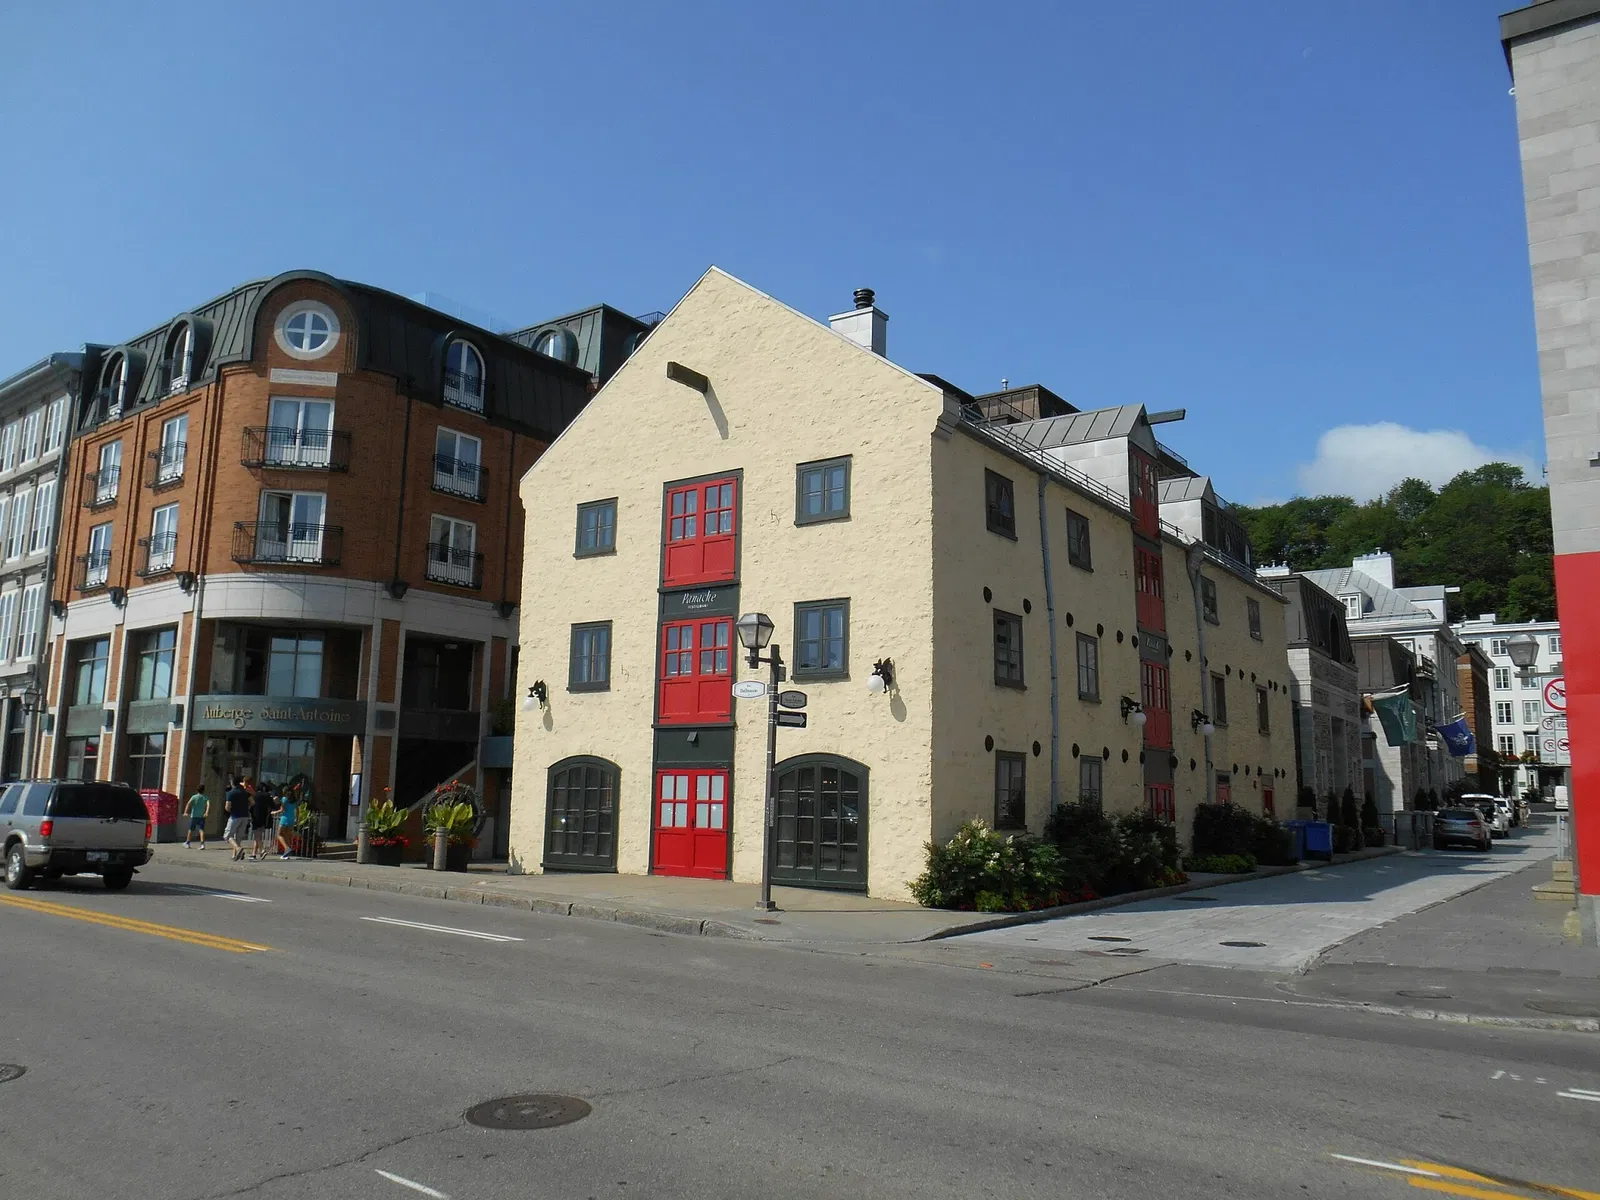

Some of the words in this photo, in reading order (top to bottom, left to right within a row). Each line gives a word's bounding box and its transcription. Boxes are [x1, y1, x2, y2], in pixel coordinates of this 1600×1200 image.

[681, 590, 717, 605] Panache
[202, 704, 254, 729] Auberge
[259, 705, 351, 723] Saint-Antoine
